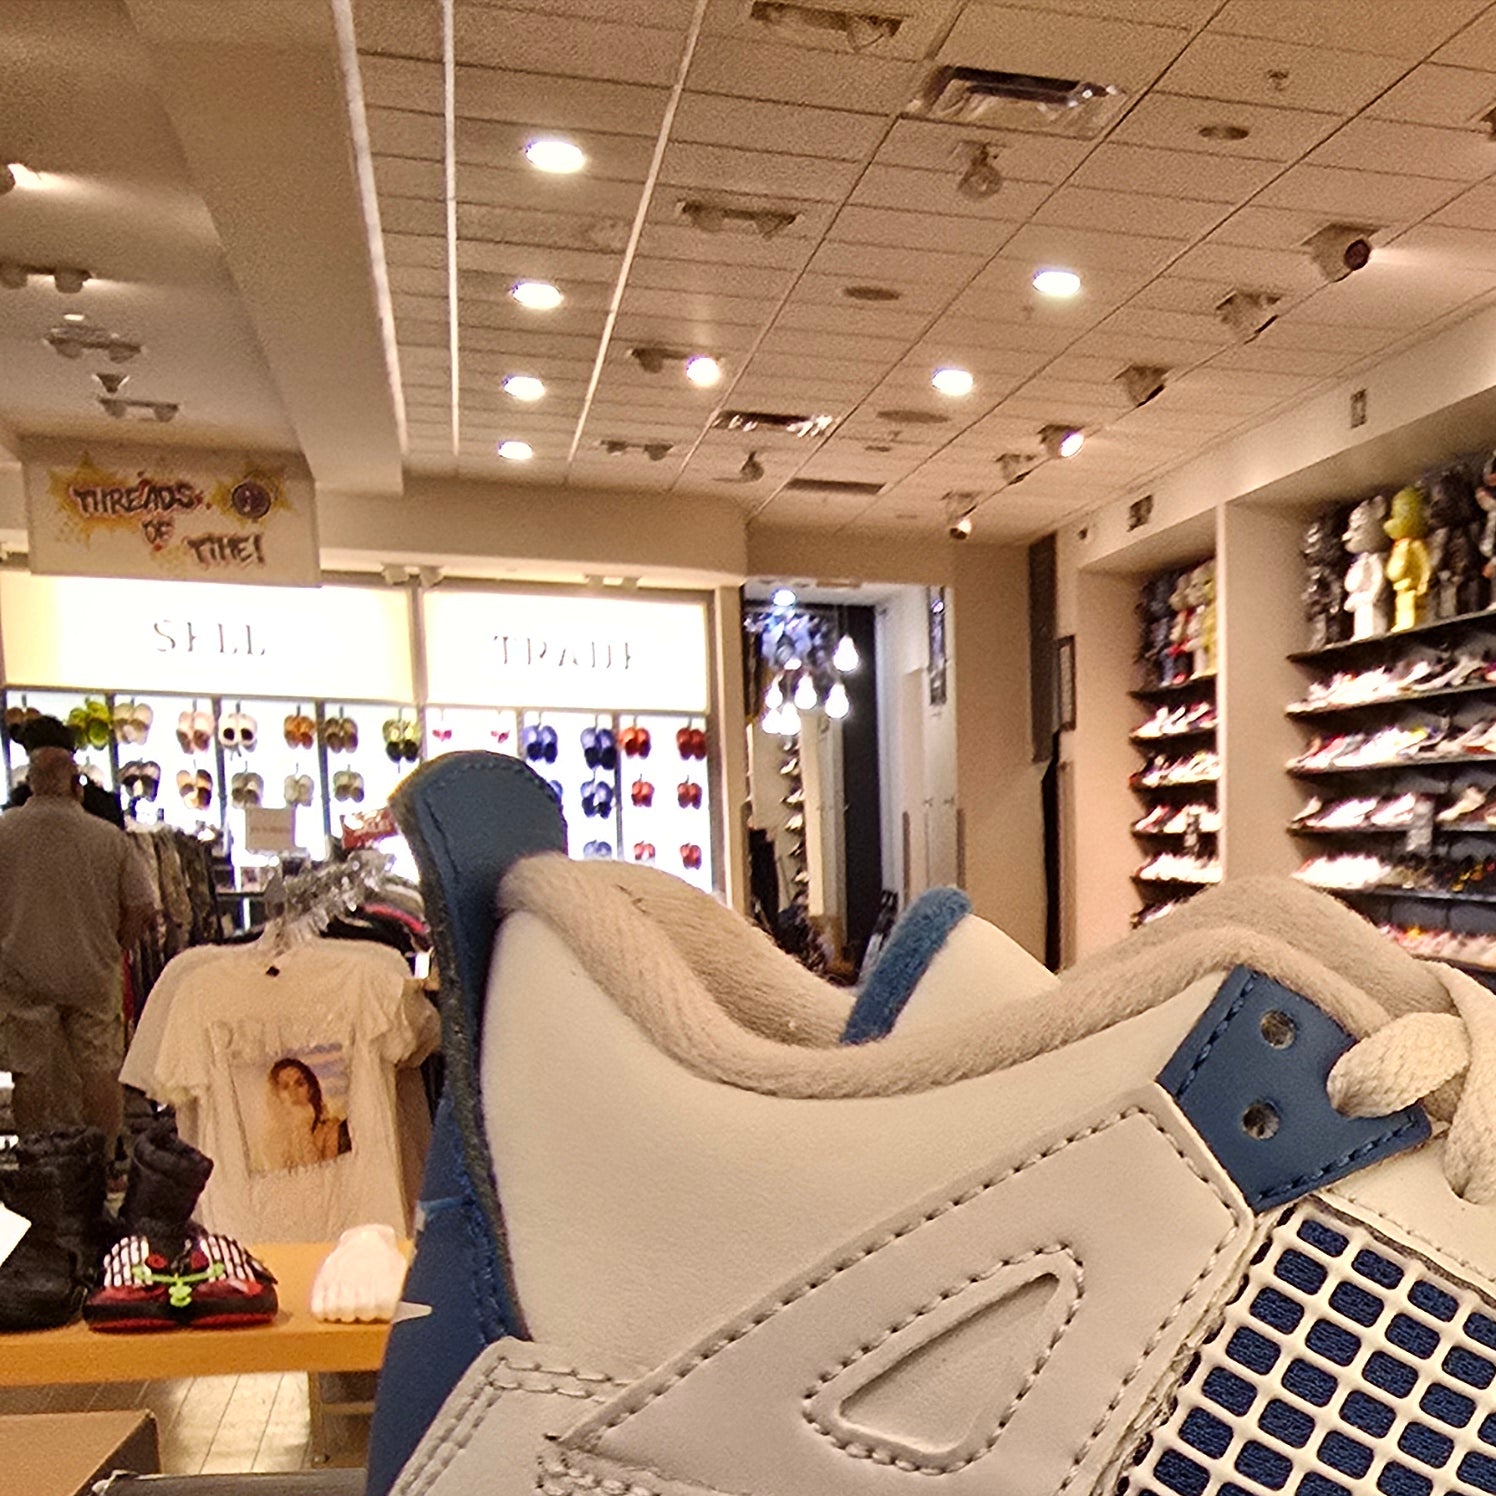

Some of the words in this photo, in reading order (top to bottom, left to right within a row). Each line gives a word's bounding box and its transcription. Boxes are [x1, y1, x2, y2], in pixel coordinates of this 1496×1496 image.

[71, 480, 197, 515] THREADS
[142, 518, 174, 544] OF
[153, 618, 266, 656] SELL
[493, 635, 632, 671] TRADE
